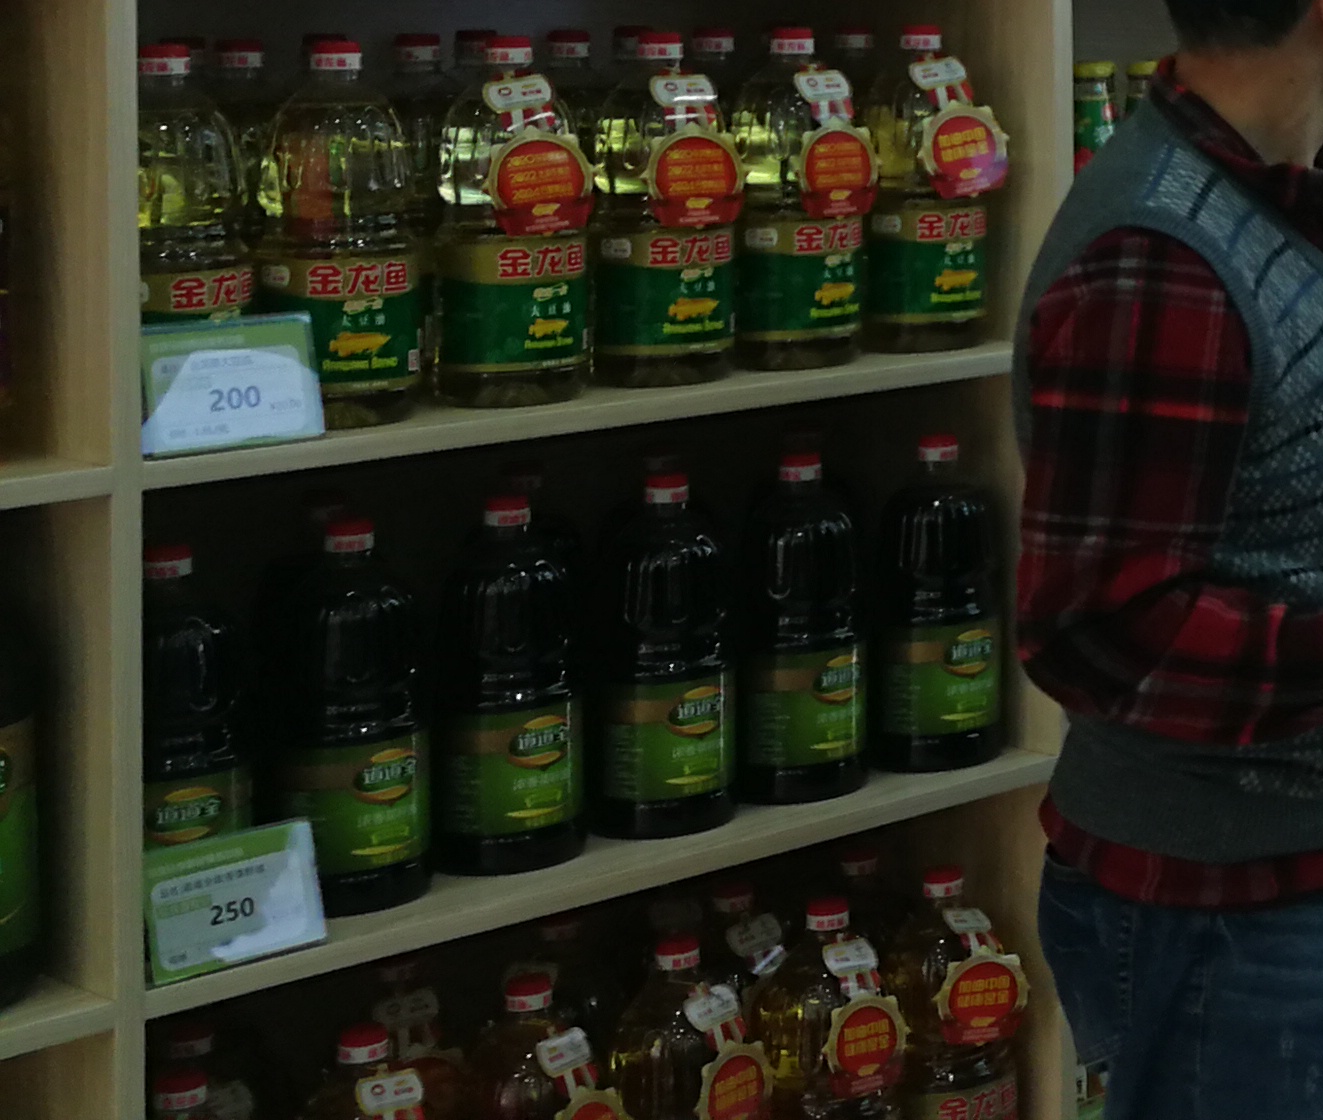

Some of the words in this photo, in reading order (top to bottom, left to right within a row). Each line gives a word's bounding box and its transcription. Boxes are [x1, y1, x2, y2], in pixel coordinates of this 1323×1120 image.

[916, 210, 987, 242] 金龙鱼
[496, 243, 586, 279] 金龙鱼
[648, 235, 732, 267] 金龙鱼
[306, 260, 409, 297] 金龙鱼
[209, 385, 262, 412] 200
[361, 754, 417, 786] 道道全
[155, 797, 222, 826] 道道全
[209, 894, 255, 927] 250
